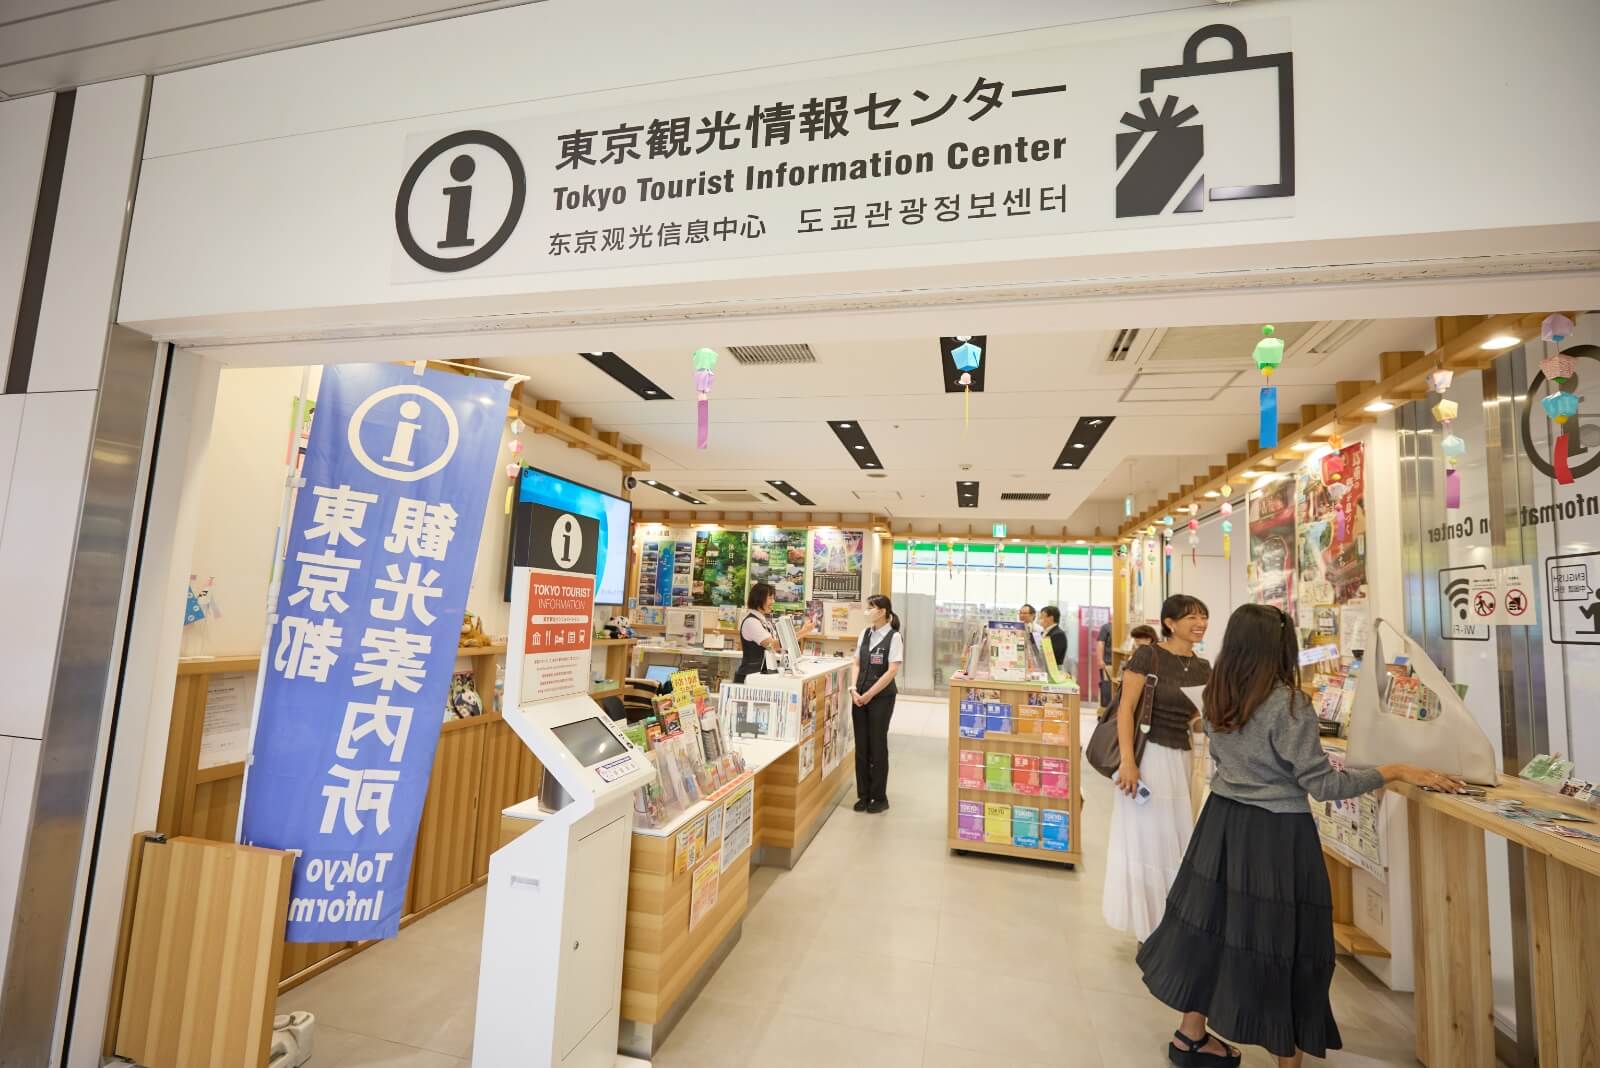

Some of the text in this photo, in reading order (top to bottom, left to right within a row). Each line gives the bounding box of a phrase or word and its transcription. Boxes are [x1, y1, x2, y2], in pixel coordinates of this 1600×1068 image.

[555, 76, 1067, 171] 東京観光情報センター
[552, 136, 1067, 212] Tokyo Tourist Information Center
[797, 183, 1067, 234] 도쿄관광정보센터
[547, 213, 767, 256] 东京观光信息中心
[533, 583, 592, 598] TOKYO TOURIST
[538, 598, 585, 610] INFORMATION
